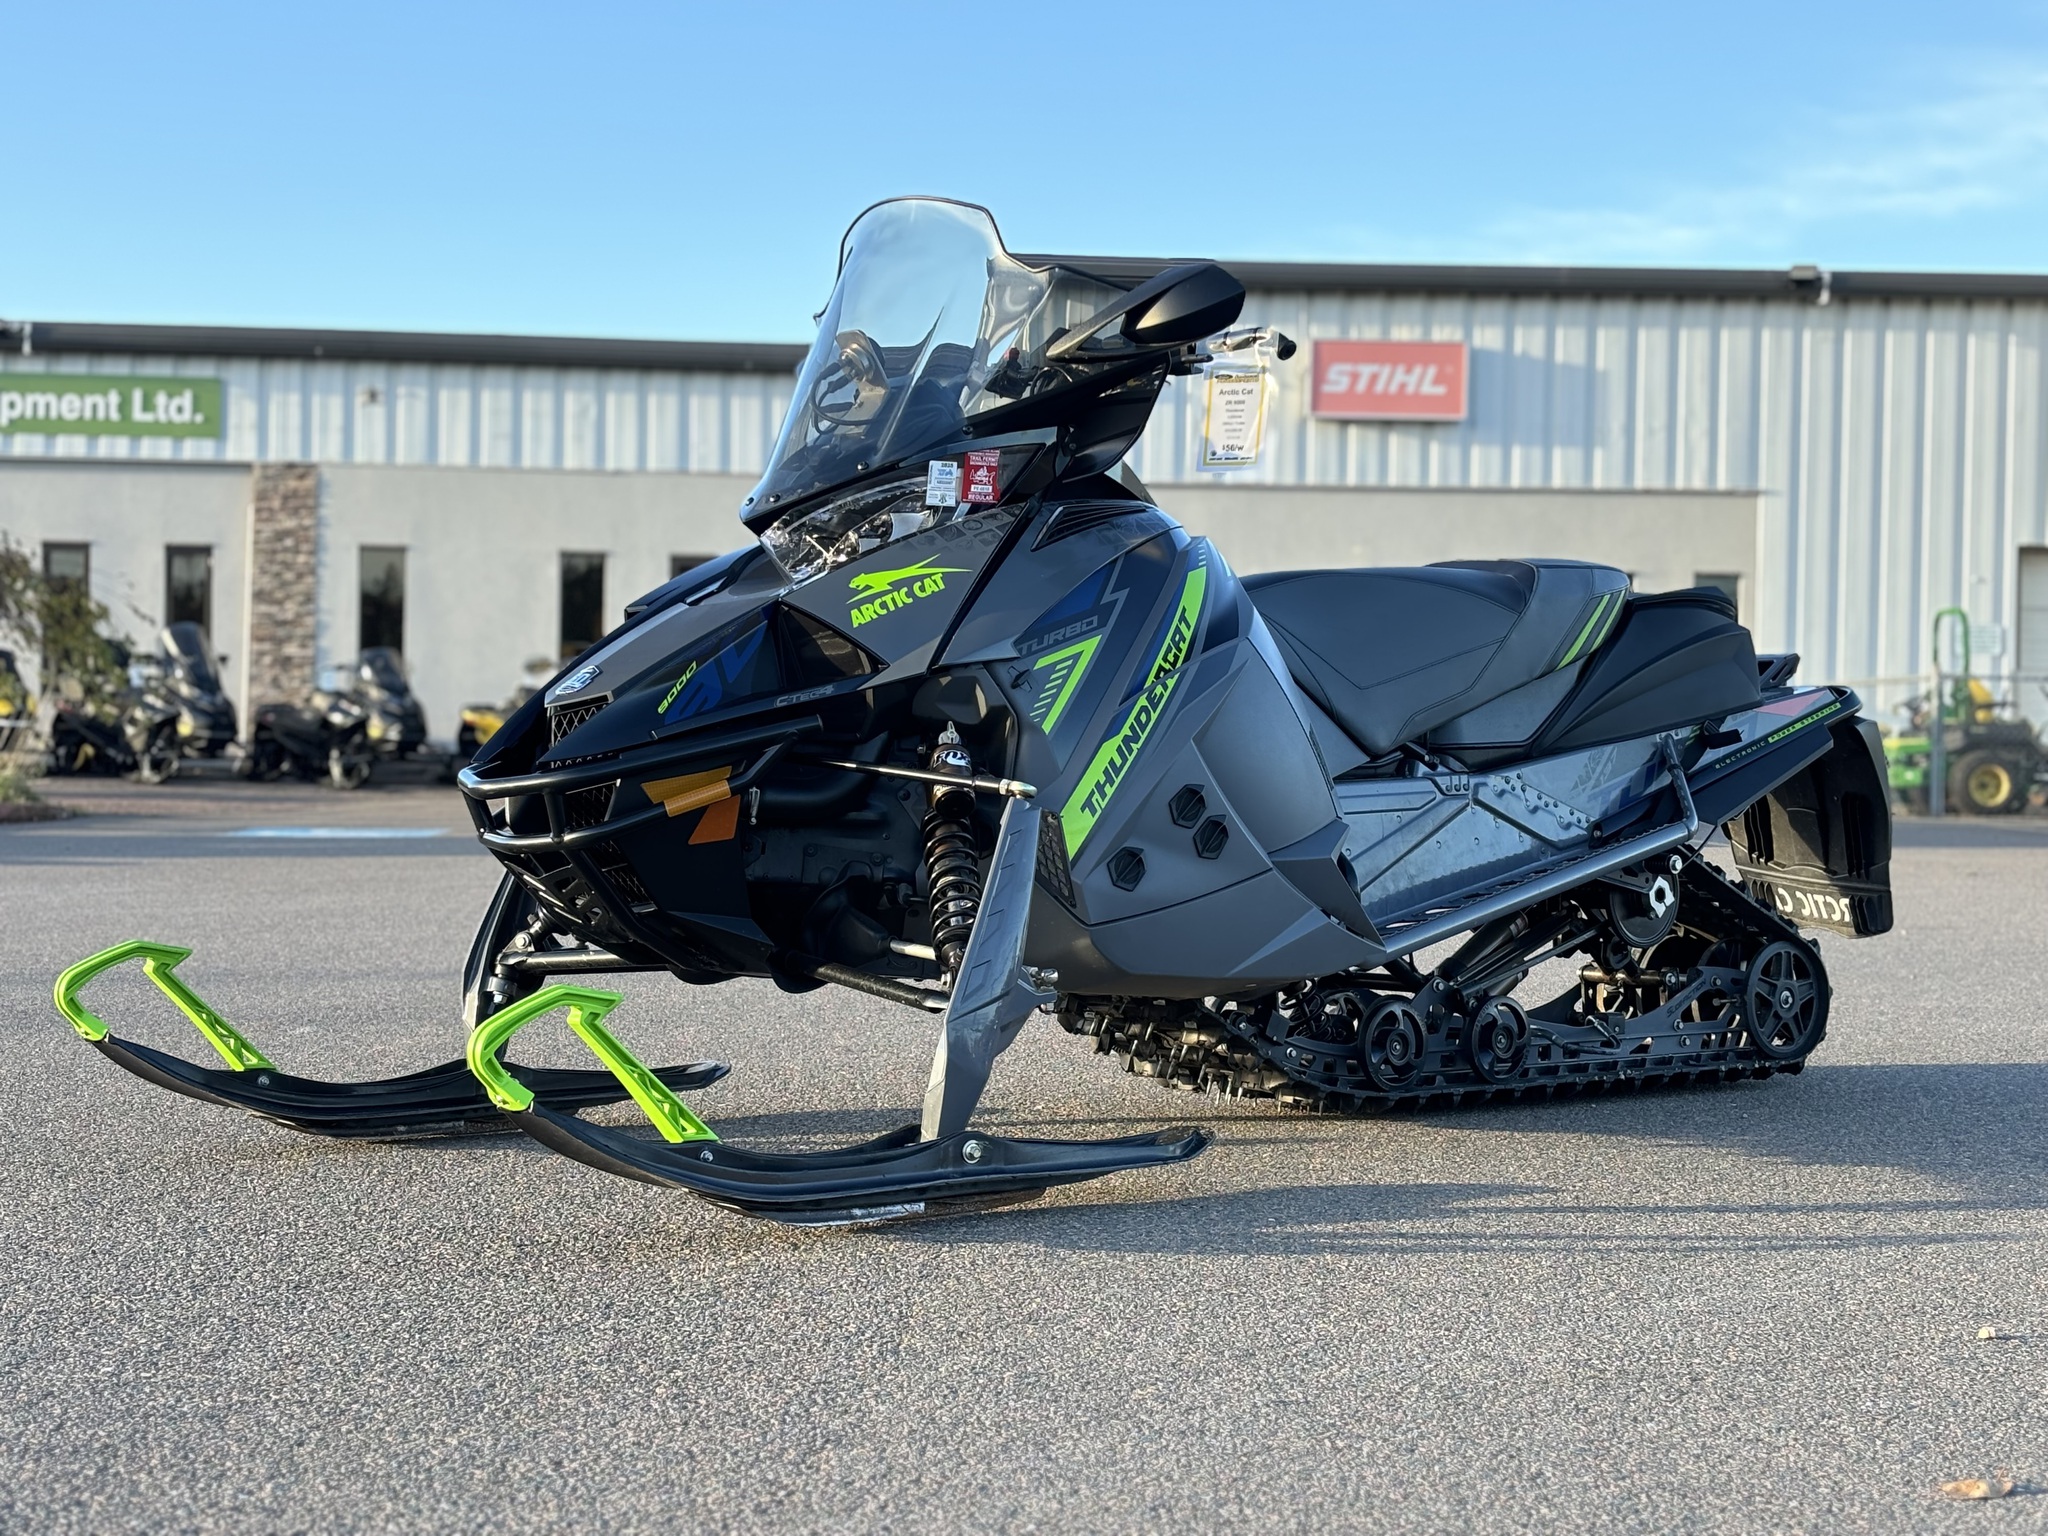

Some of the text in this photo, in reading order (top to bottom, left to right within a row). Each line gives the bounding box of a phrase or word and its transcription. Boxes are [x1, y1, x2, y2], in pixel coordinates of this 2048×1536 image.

[1218, 388, 1254, 396] Arctic Cat
[1320, 362, 1448, 396] STIHL
[0, 386, 205, 428] pment Ltd.
[850, 573, 946, 628] ARCTIC CAT
[1016, 615, 1099, 656] TURBO
[657, 660, 697, 714] 9000
[1080, 605, 1193, 819] THUNDERCAT
[1714, 703, 1840, 770] ELECTRONIC POWER STEERING
